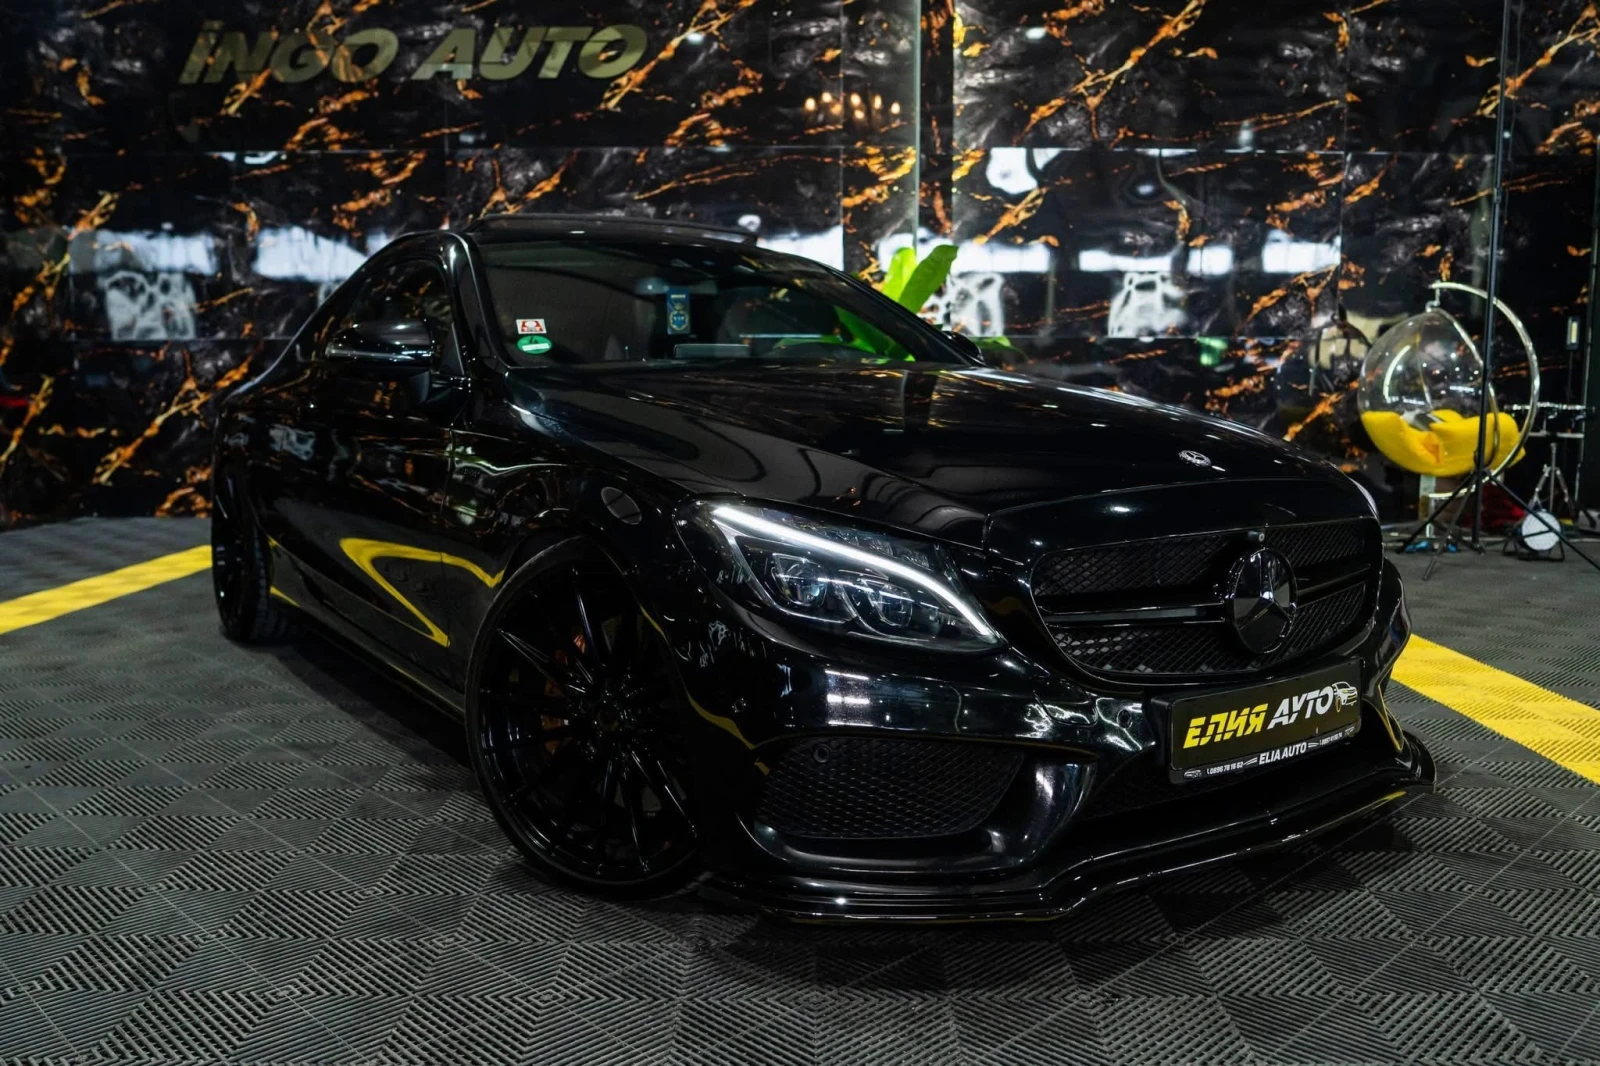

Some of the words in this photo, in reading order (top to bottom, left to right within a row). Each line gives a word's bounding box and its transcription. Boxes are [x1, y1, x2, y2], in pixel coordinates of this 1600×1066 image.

[411, 24, 648, 81] AUTO
[1183, 703, 1268, 749] ЕЛИЯ
[1259, 748, 1280, 765] ELIA
[1282, 741, 1307, 758] AUTO
